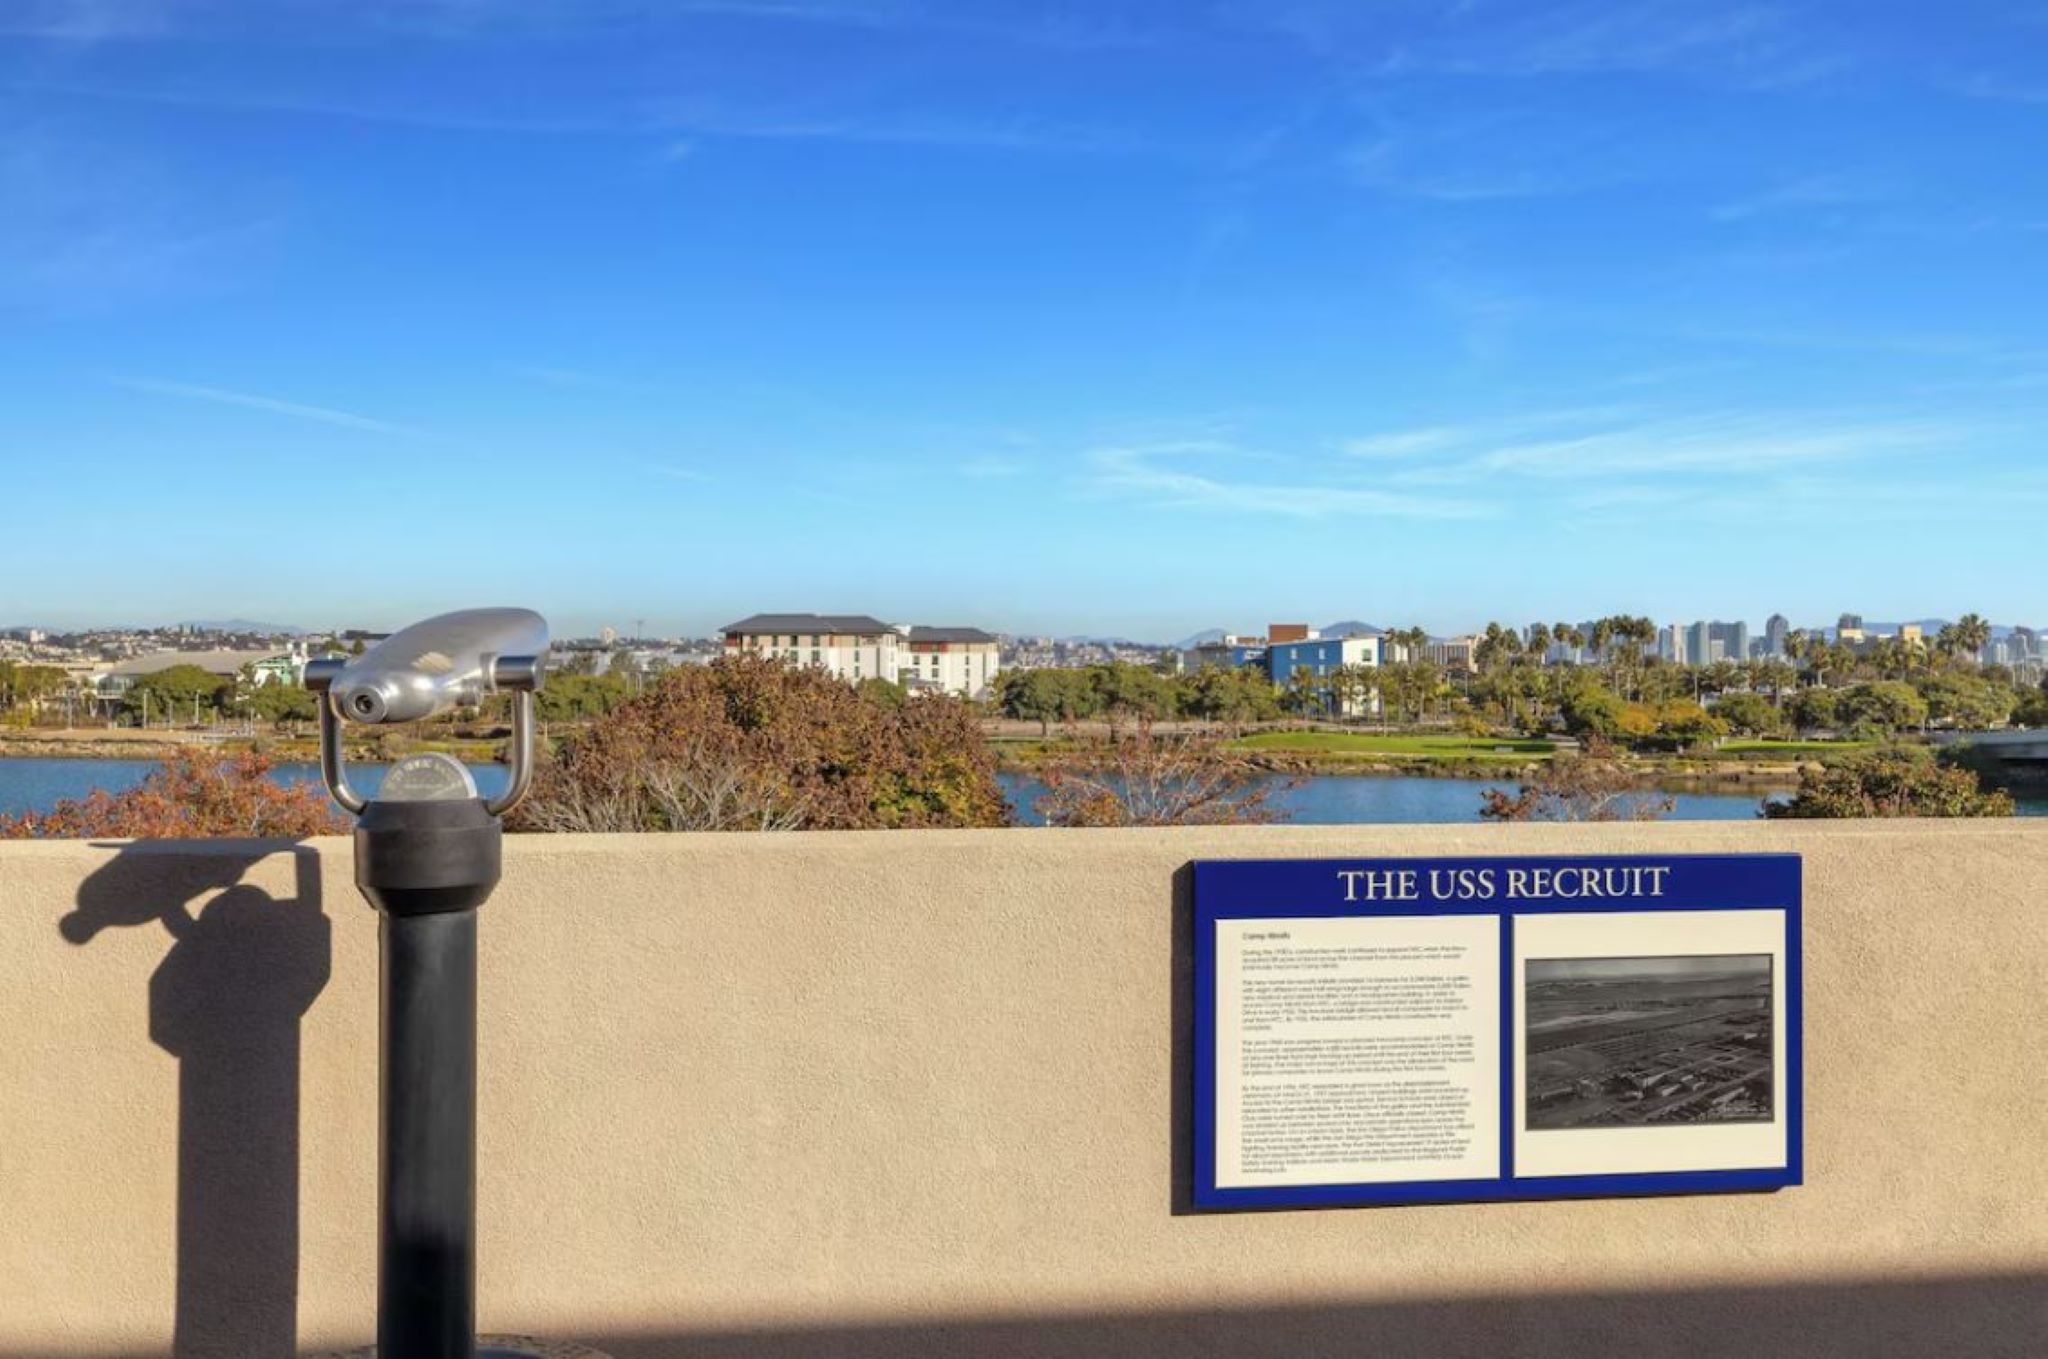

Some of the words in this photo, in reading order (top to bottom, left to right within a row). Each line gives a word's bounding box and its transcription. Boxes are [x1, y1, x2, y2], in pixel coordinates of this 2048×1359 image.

[1337, 869, 1419, 901] THE
[1428, 868, 1496, 900] USS
[1505, 866, 1671, 899] RECRUIT
